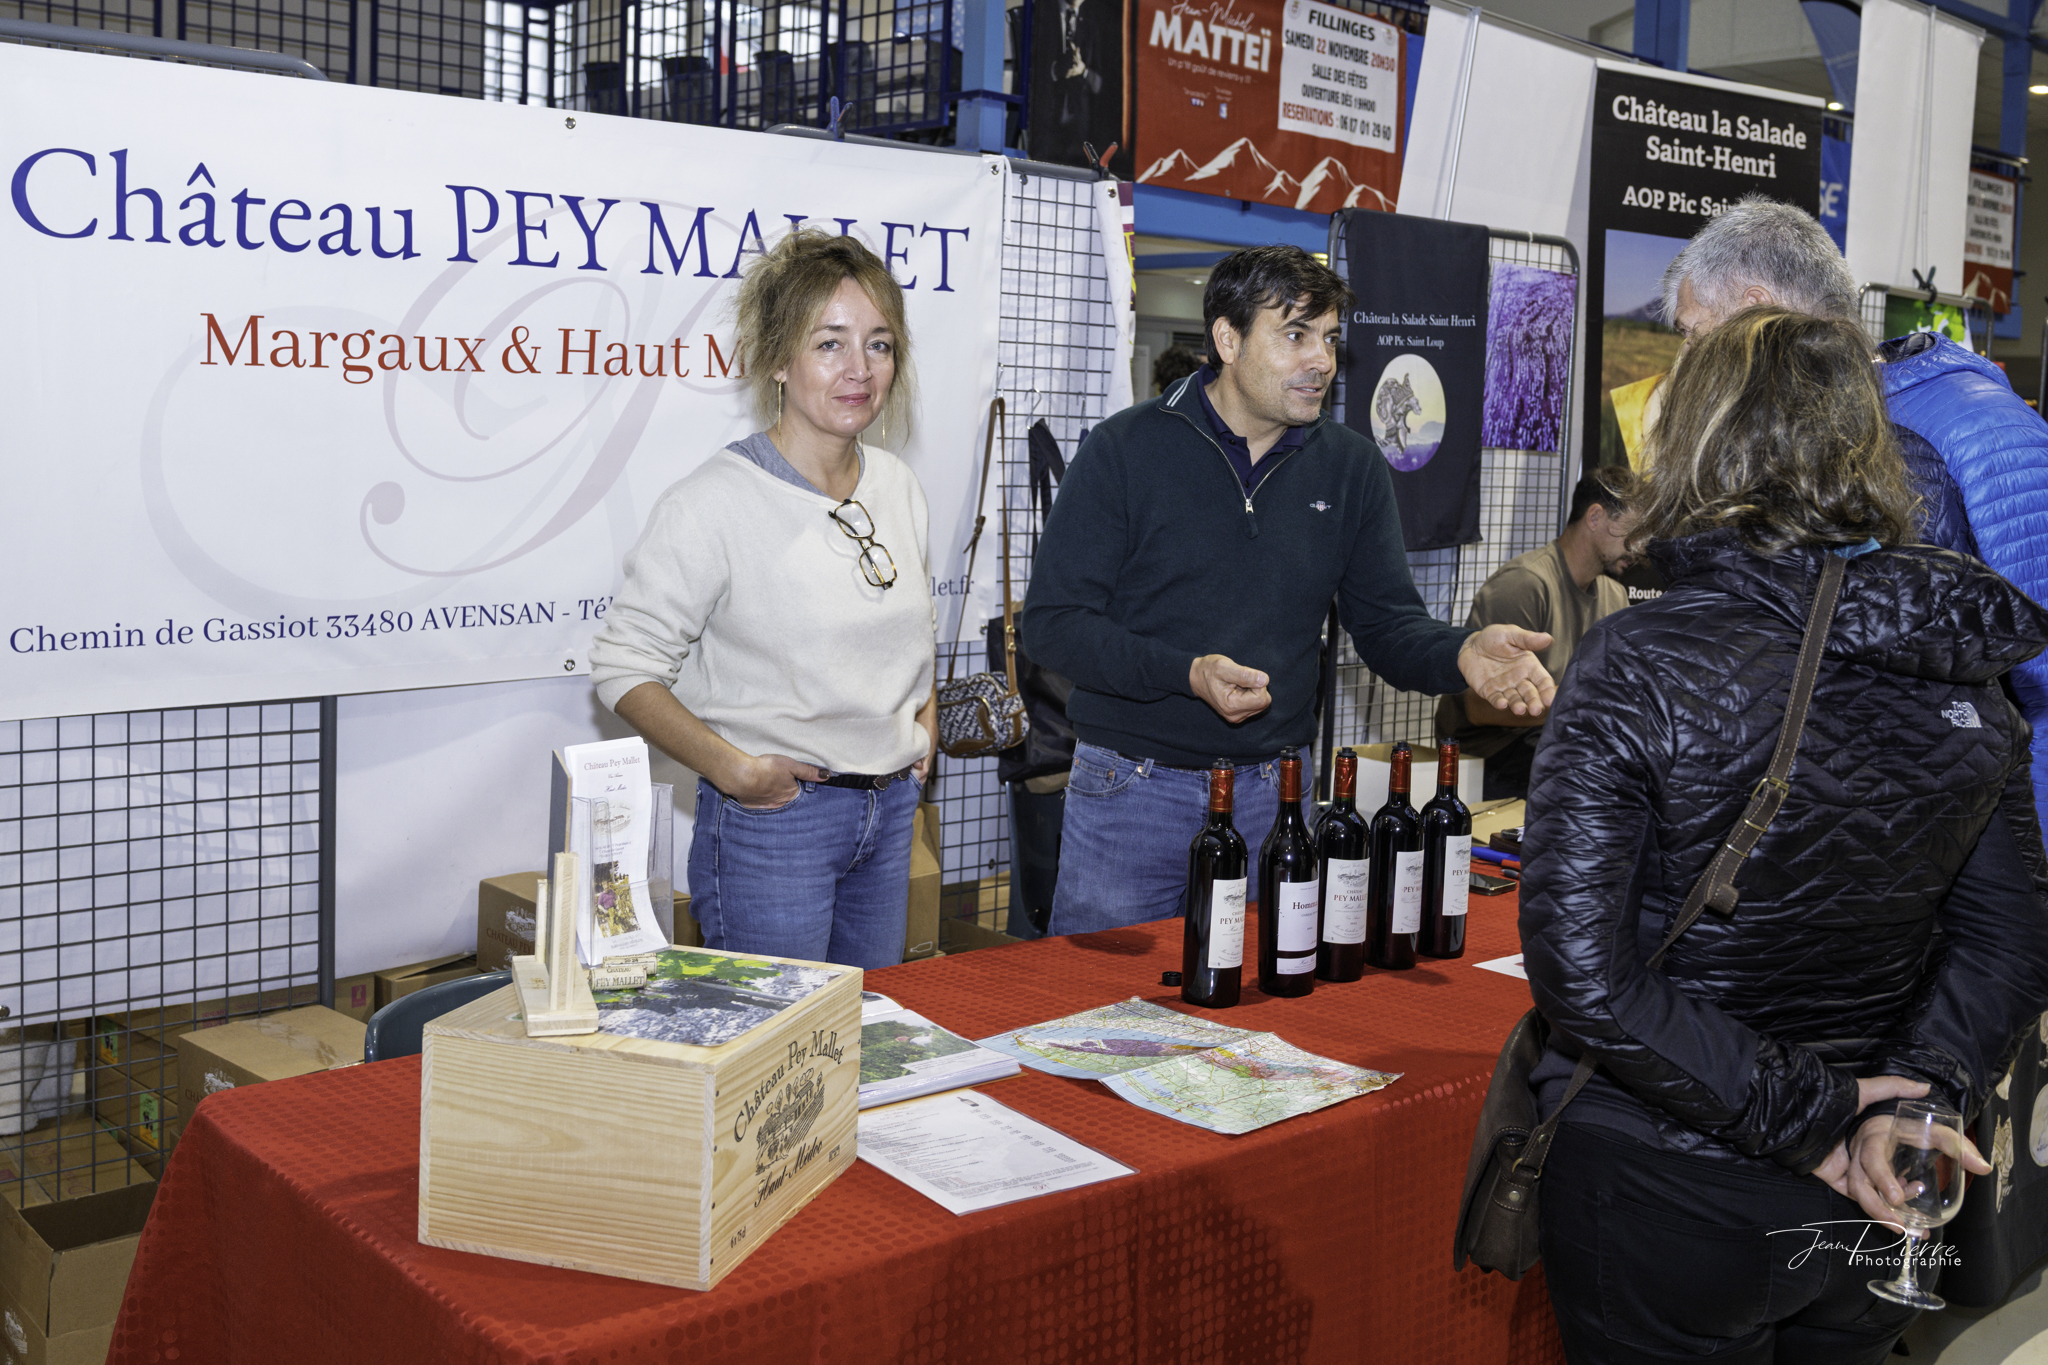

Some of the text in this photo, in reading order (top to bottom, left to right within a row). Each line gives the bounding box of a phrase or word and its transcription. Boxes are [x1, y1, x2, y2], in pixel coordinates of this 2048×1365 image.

[1308, 9, 1376, 41] FILLINGES
[1149, 9, 1272, 73] MATTEÏ
[1285, 29, 1396, 73] SAMEDI 22 NOVEMBRE 20H30
[1312, 63, 1368, 90] SALLE DES FÊTES
[1302, 83, 1340, 105] OUVERTURE
[1360, 119, 1370, 136] 01
[1612, 95, 1807, 150] Château la Salade
[1646, 135, 1777, 178] Saint-Henri
[1622, 185, 1665, 210] AOP
[1667, 191, 1698, 215] Pic
[10, 147, 970, 293] Château PEY MAET
[1353, 311, 1477, 327] Château la Salade Saint Henri
[199, 312, 752, 385] Margaux & Haut M
[1377, 335, 1445, 350] AOP Pic Saint Loup
[1628, 586, 1663, 599] Route
[9, 622, 146, 653] Chemin
[155, 618, 194, 646] de
[203, 614, 320, 643] Gassiot
[326, 609, 414, 639] 33480
[420, 601, 556, 631] AVENSAN
[1940, 709, 1971, 719] NORTH
[1951, 701, 1968, 711] THE
[1950, 718, 1971, 728] FACE
[609, 758, 621, 769] Pey
[622, 756, 641, 766] Mallet
[1334, 894, 1348, 902] PEY
[1219, 917, 1233, 925] PEY
[486, 927, 518, 949] CHÂTEAU
[612, 975, 645, 986] MALLET
[734, 1030, 844, 1143] Château Pey Mallet
